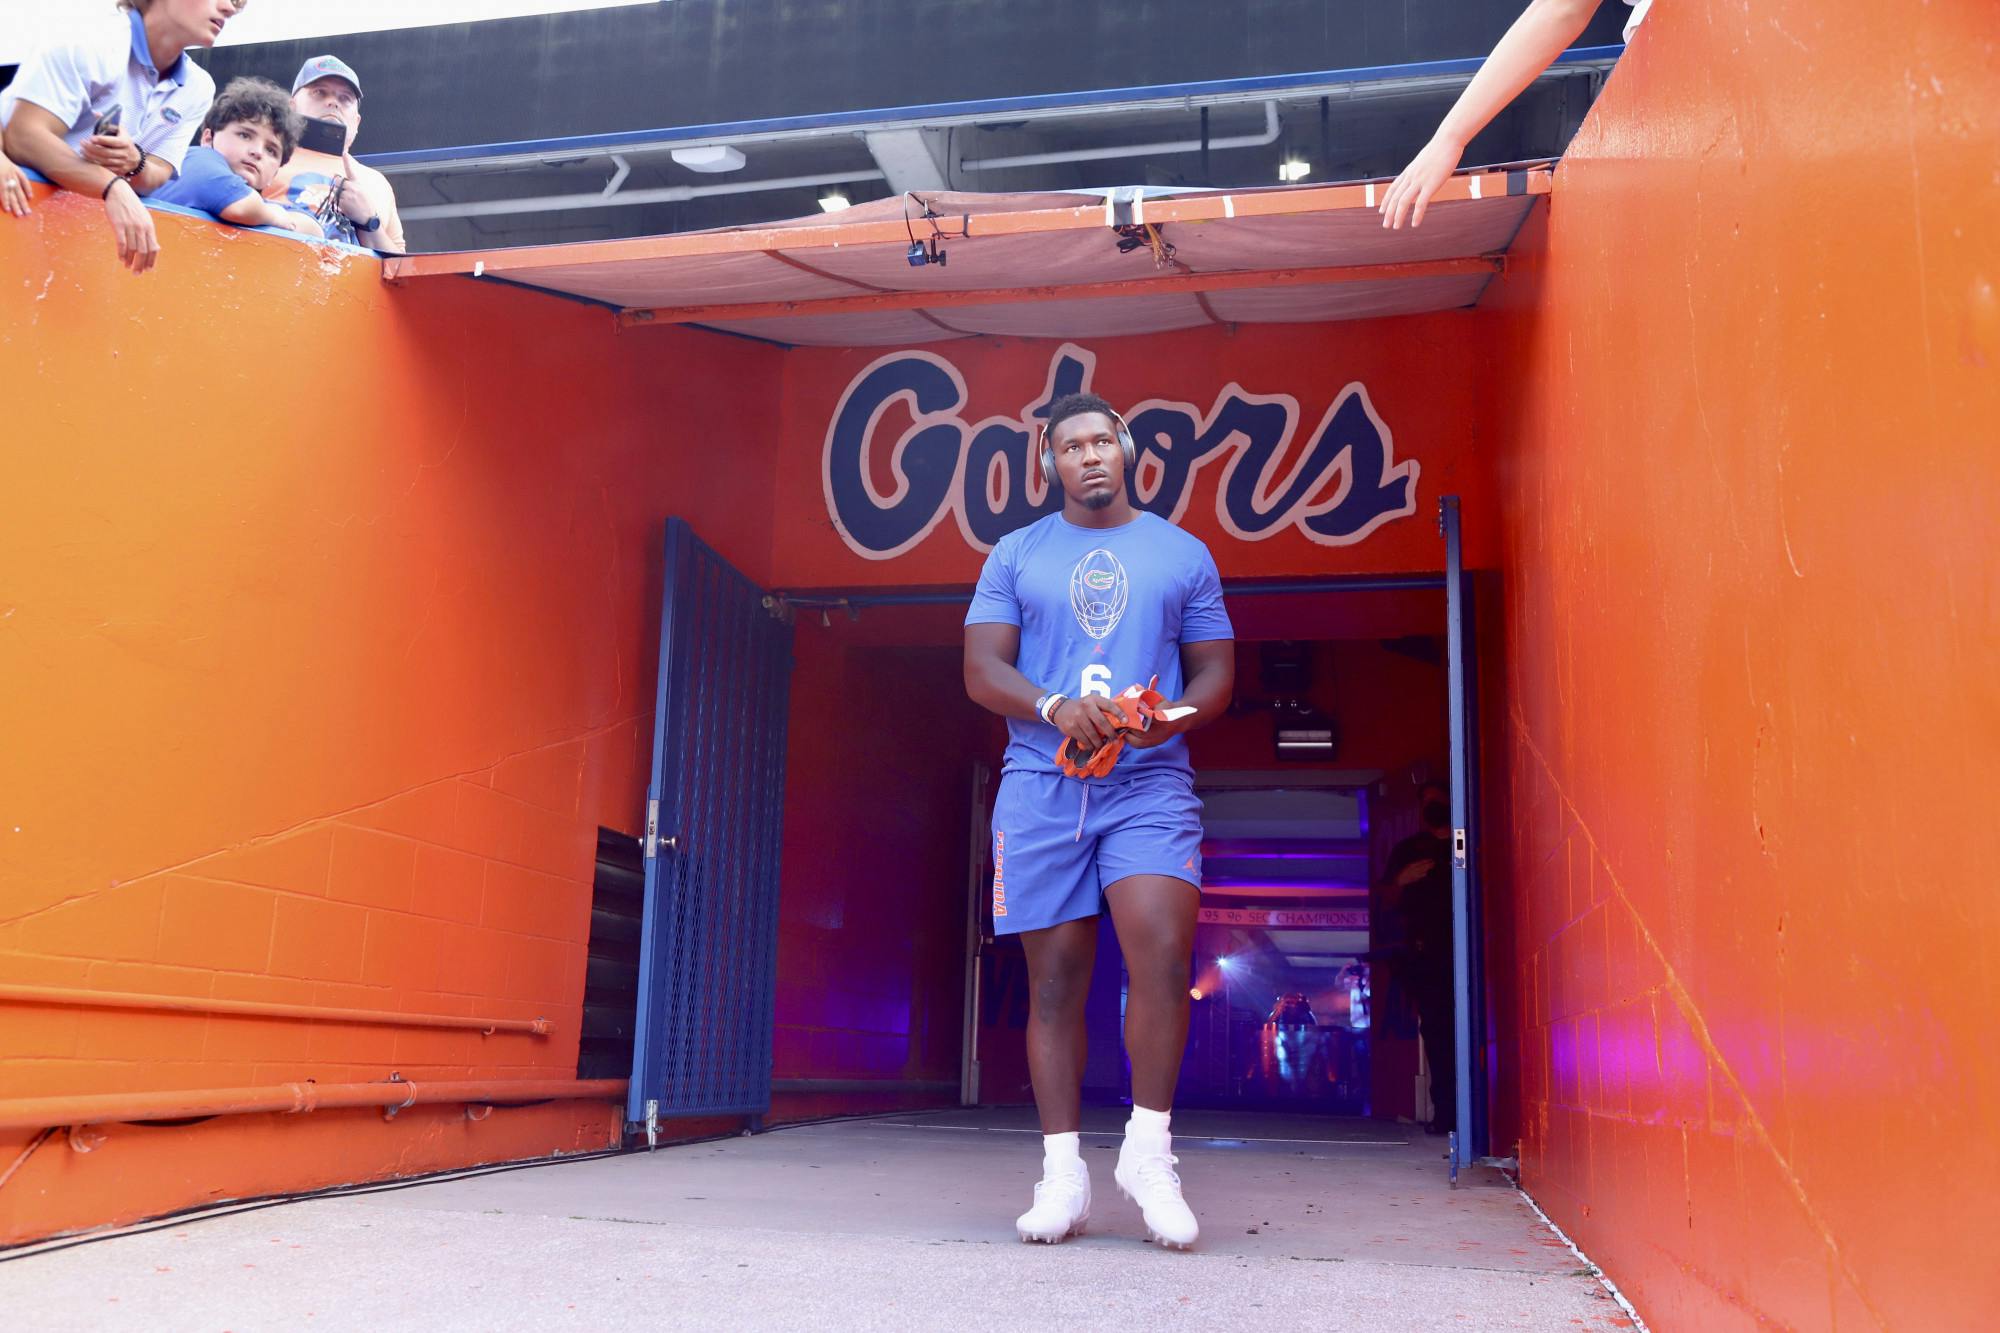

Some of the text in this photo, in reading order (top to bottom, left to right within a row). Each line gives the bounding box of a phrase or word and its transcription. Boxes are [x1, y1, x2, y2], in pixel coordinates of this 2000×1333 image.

[1080, 663, 1112, 699] 6
[1248, 911, 1271, 923] SEC
[1276, 912, 1359, 925] CHAMPIONS
